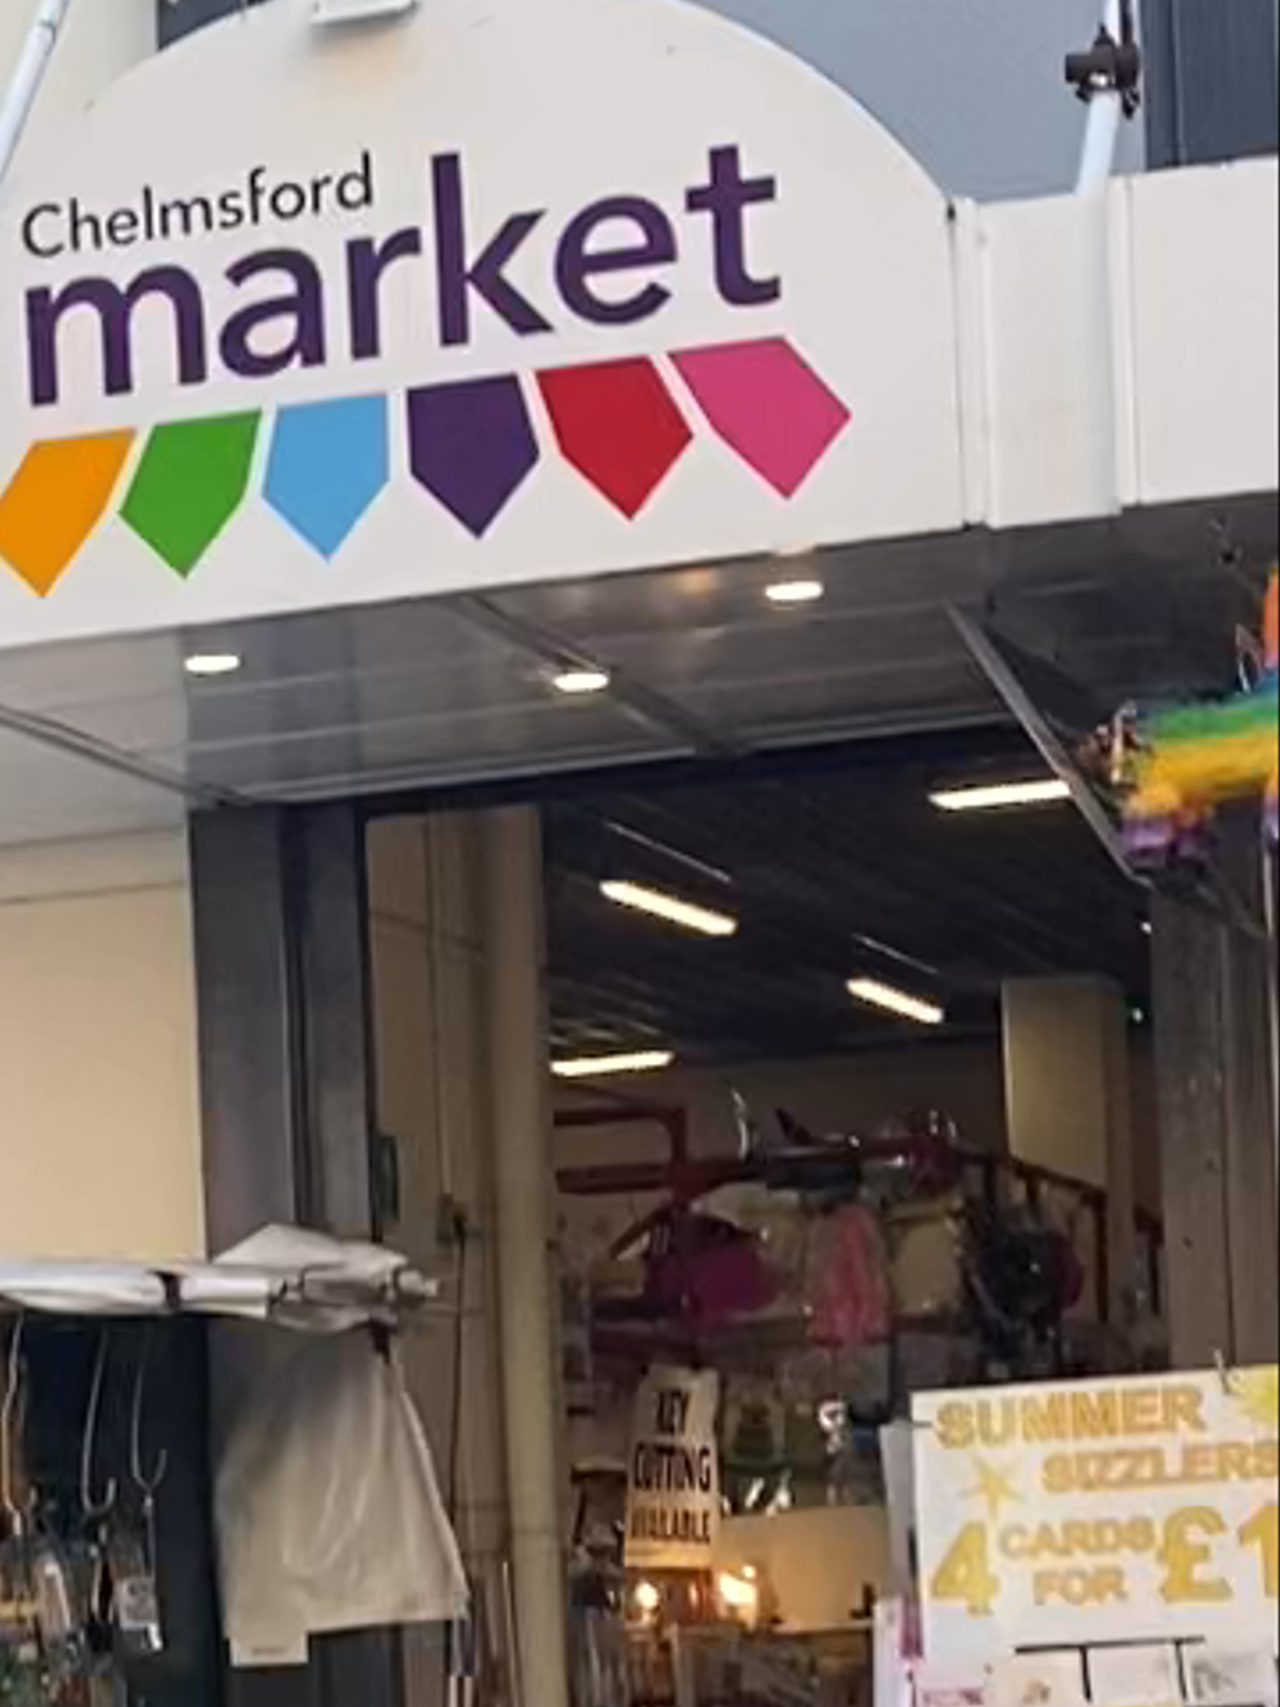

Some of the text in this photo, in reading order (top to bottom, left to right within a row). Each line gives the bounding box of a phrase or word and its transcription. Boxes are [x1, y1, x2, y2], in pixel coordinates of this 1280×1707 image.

[21, 150, 375, 258] Chelmsford
[23, 145, 782, 408] market
[937, 1383, 1207, 1450] SUMMER
[1042, 1440, 1278, 1493] SIZZLERS
[929, 1519, 997, 1618] 4
[998, 1514, 1157, 1559] CARDS
[1032, 1566, 1129, 1607] FOR
